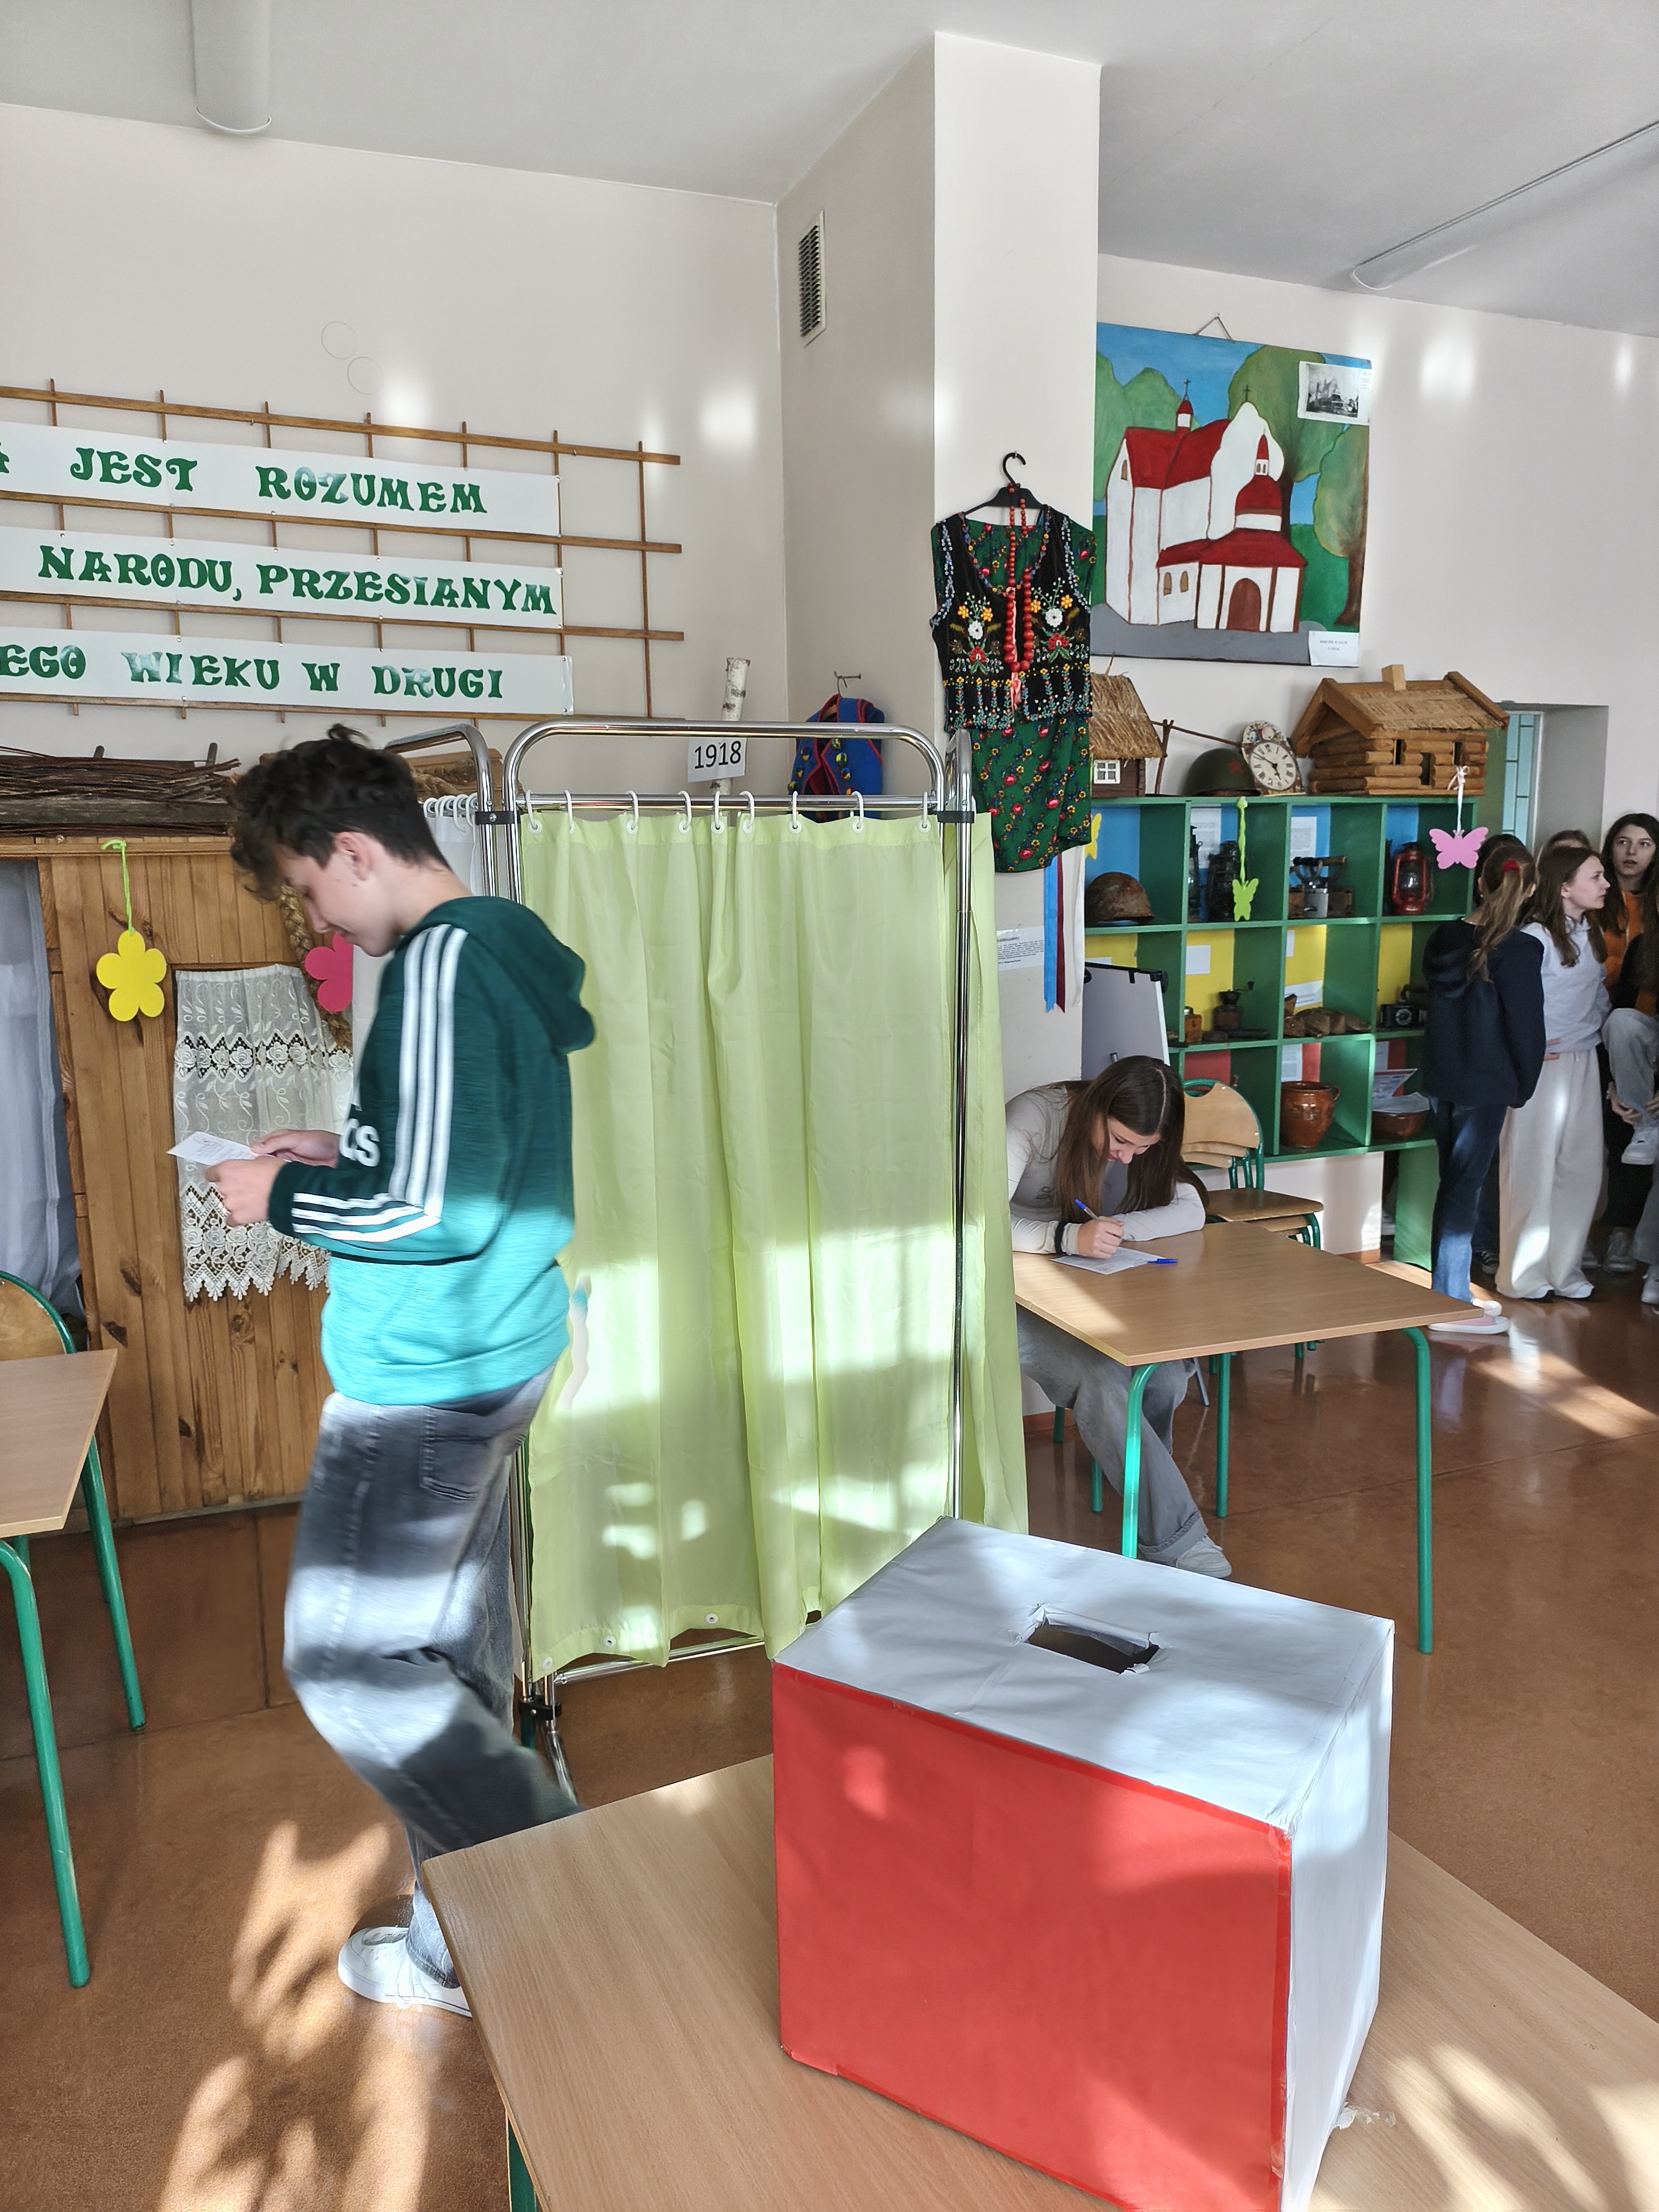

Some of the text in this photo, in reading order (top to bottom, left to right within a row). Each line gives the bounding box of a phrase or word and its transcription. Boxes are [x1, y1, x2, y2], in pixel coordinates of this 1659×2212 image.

[69, 447, 487, 513] JEST ROZUMEM
[38, 545, 556, 615] NARODU, PRZESIANYM
[122, 652, 280, 691] WIEKU
[301, 662, 340, 692] W
[371, 666, 503, 699] DRUGI
[695, 741, 742, 769] 1918
